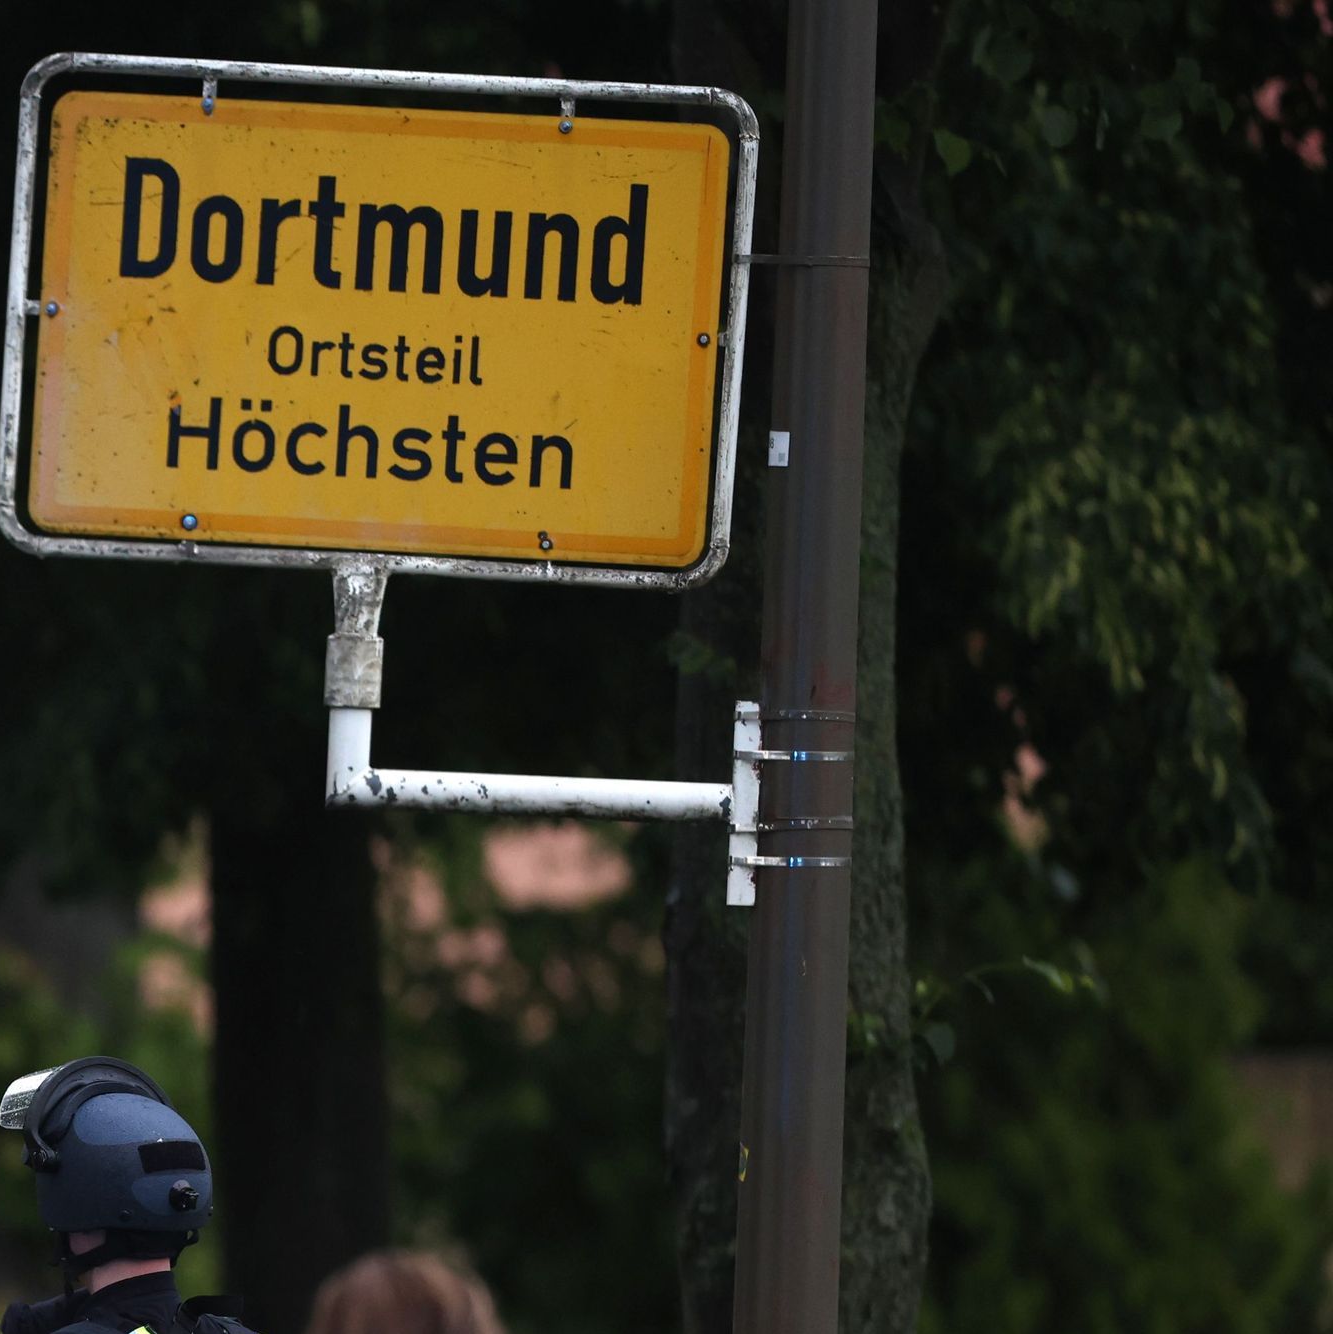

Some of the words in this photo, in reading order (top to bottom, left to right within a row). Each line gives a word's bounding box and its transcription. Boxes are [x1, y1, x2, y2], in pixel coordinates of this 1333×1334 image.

[119, 155, 649, 306] Dortmund
[267, 325, 483, 386] Ortsteil
[166, 396, 574, 490] Höchsten
